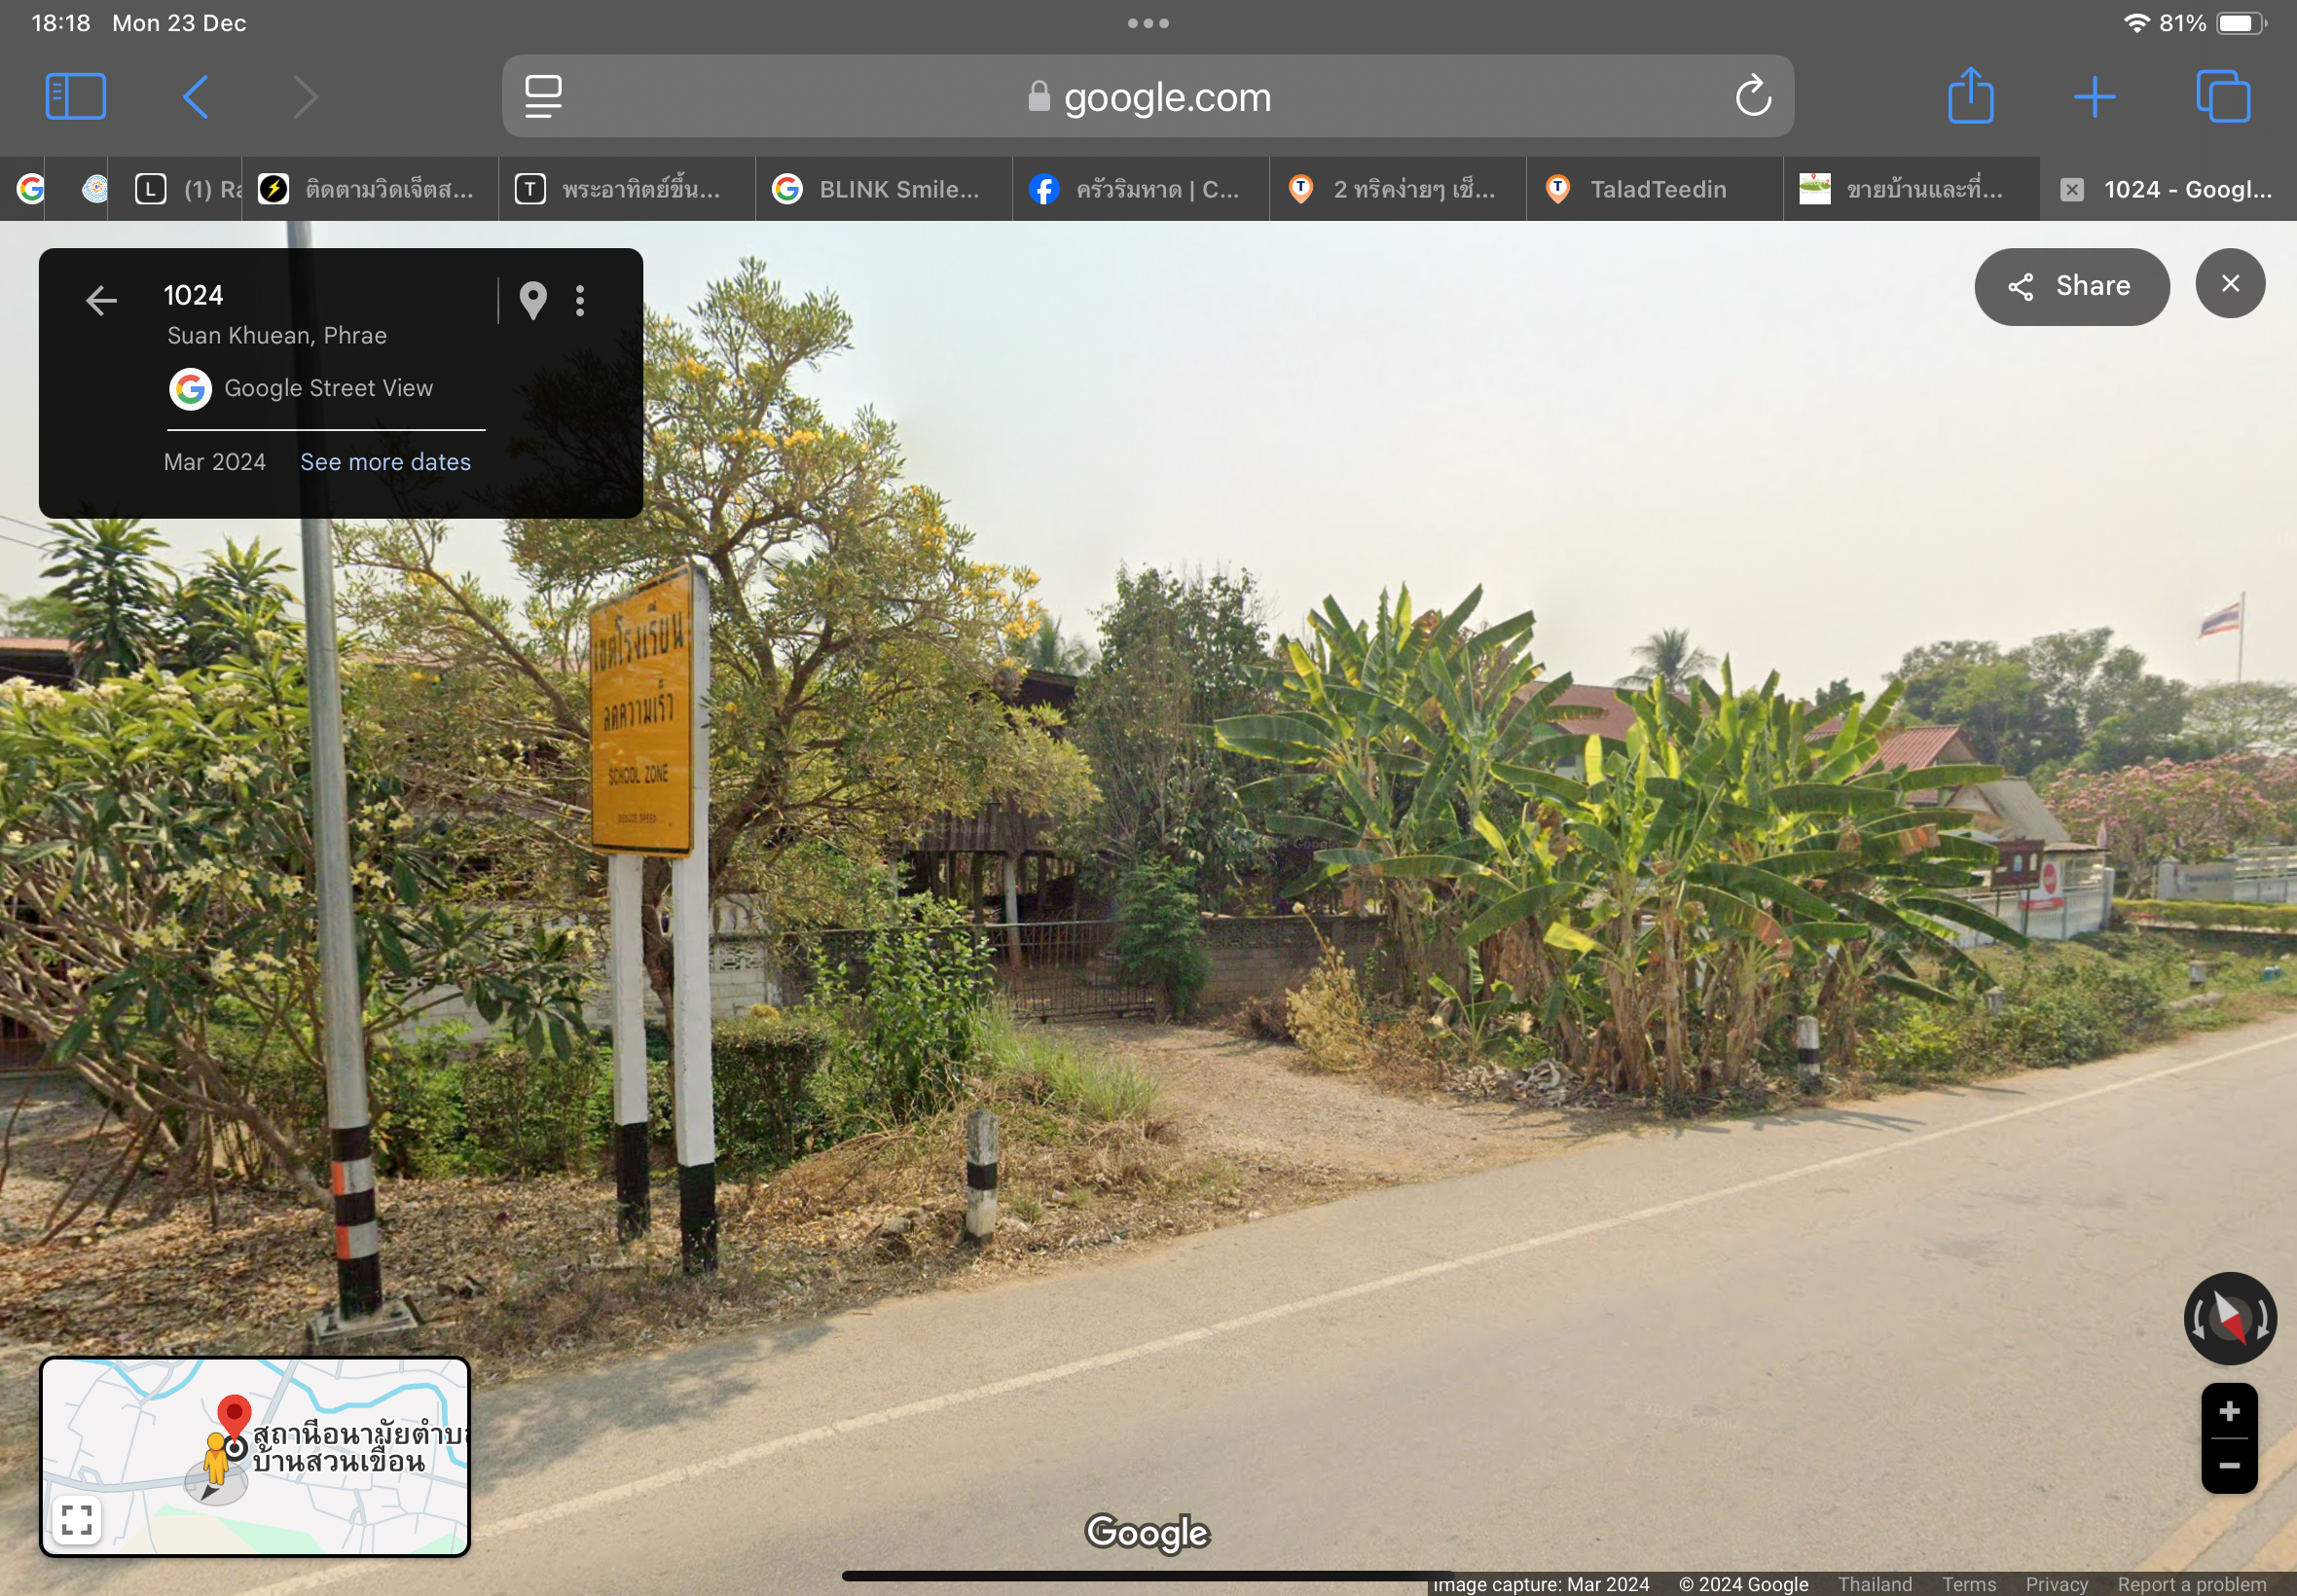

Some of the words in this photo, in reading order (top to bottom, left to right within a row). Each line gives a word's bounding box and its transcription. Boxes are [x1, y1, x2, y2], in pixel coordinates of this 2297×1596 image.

[32, 15, 91, 32] 18:18
[114, 15, 159, 31] Mon
[168, 15, 195, 32] 23
[204, 15, 246, 31] Dec
[2160, 15, 2206, 32] 81%
[1066, 81, 1270, 119] google.com
[146, 182, 156, 196] L
[186, 180, 211, 201] (1)
[525, 182, 536, 196] T
[821, 181, 889, 198] BLINK
[897, 180, 978, 199] Smile...
[1077, 177, 1182, 198] ครัวริมหาด
[1335, 181, 1347, 198] 2
[1354, 177, 1444, 202] ทริคง่ายๆ
[1591, 180, 1726, 198] TaladTeedin
[2105, 180, 2161, 199] 1024
[2186, 180, 2272, 202] Googl...
[595, 600, 683, 671] เขตโรงเรียน
[603, 679, 674, 732] ลดความเร็ว
[608, 767, 640, 785] SCHOOL
[645, 764, 669, 783] ZONE
